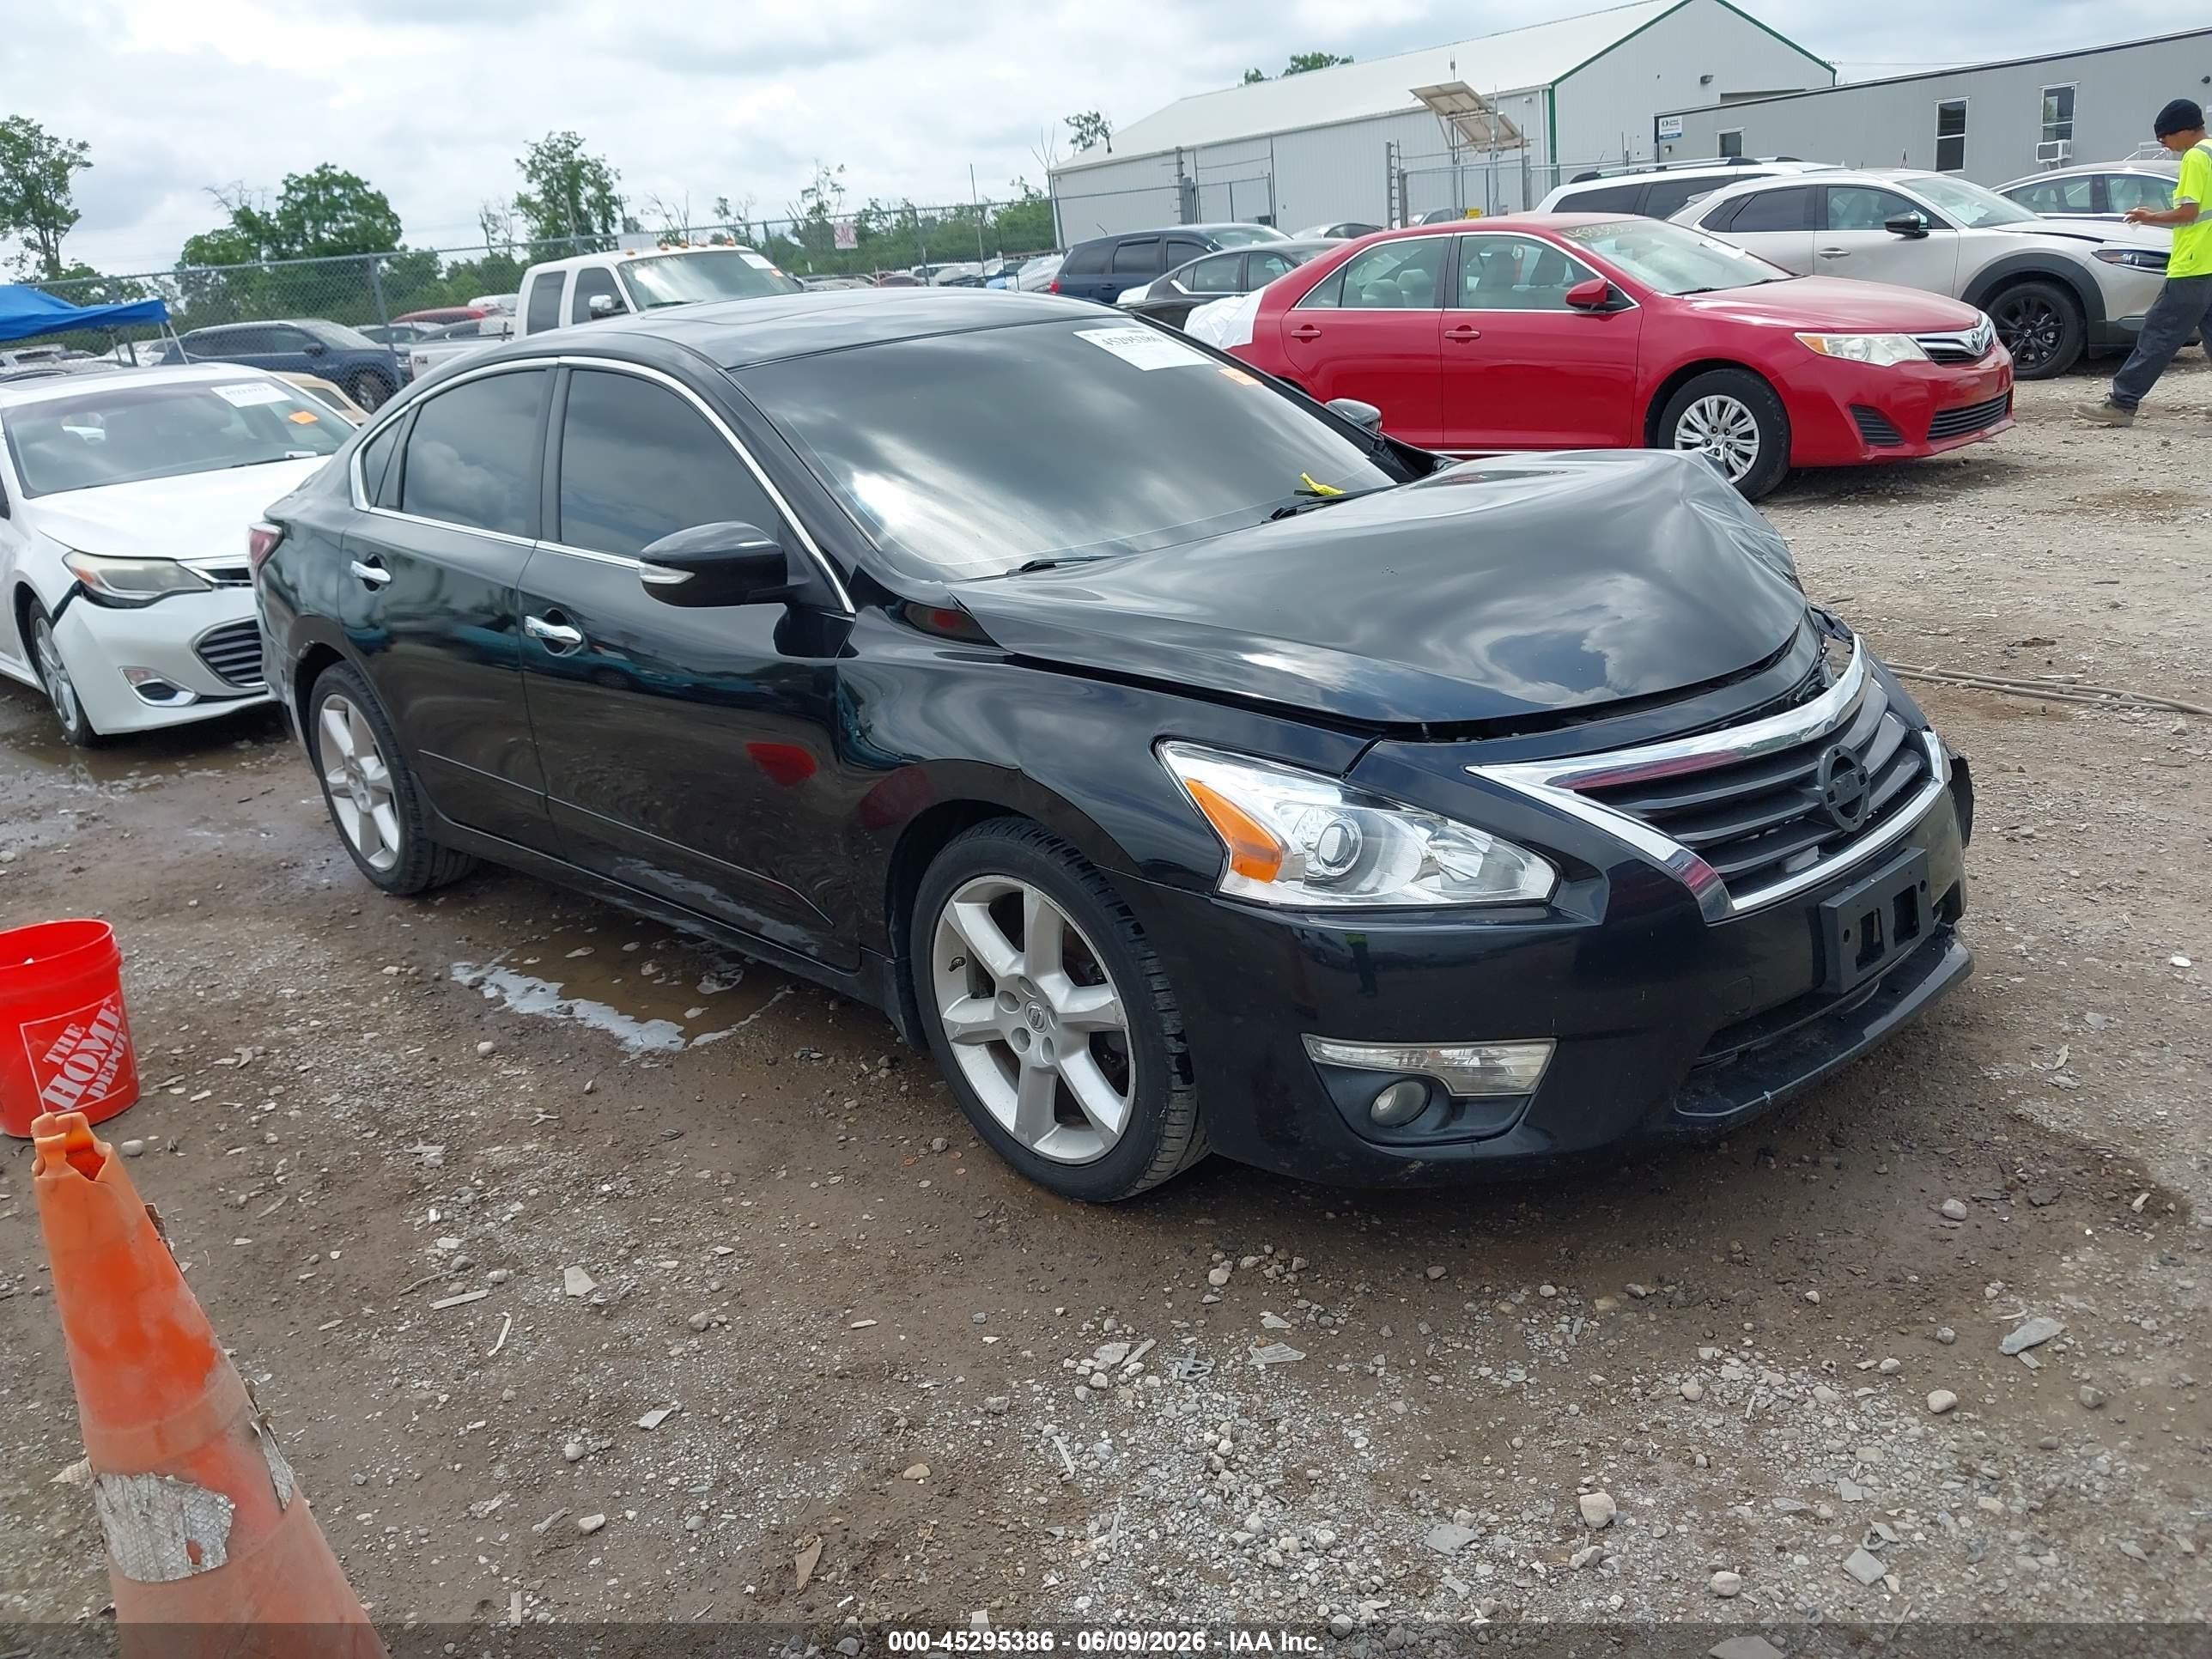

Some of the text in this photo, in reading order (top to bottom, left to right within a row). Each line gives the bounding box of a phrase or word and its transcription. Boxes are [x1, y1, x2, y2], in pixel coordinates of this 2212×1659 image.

[41, 998, 122, 1109] HOME
[42, 1023, 87, 1066] THE
[86, 1027, 128, 1100] DEPOT
